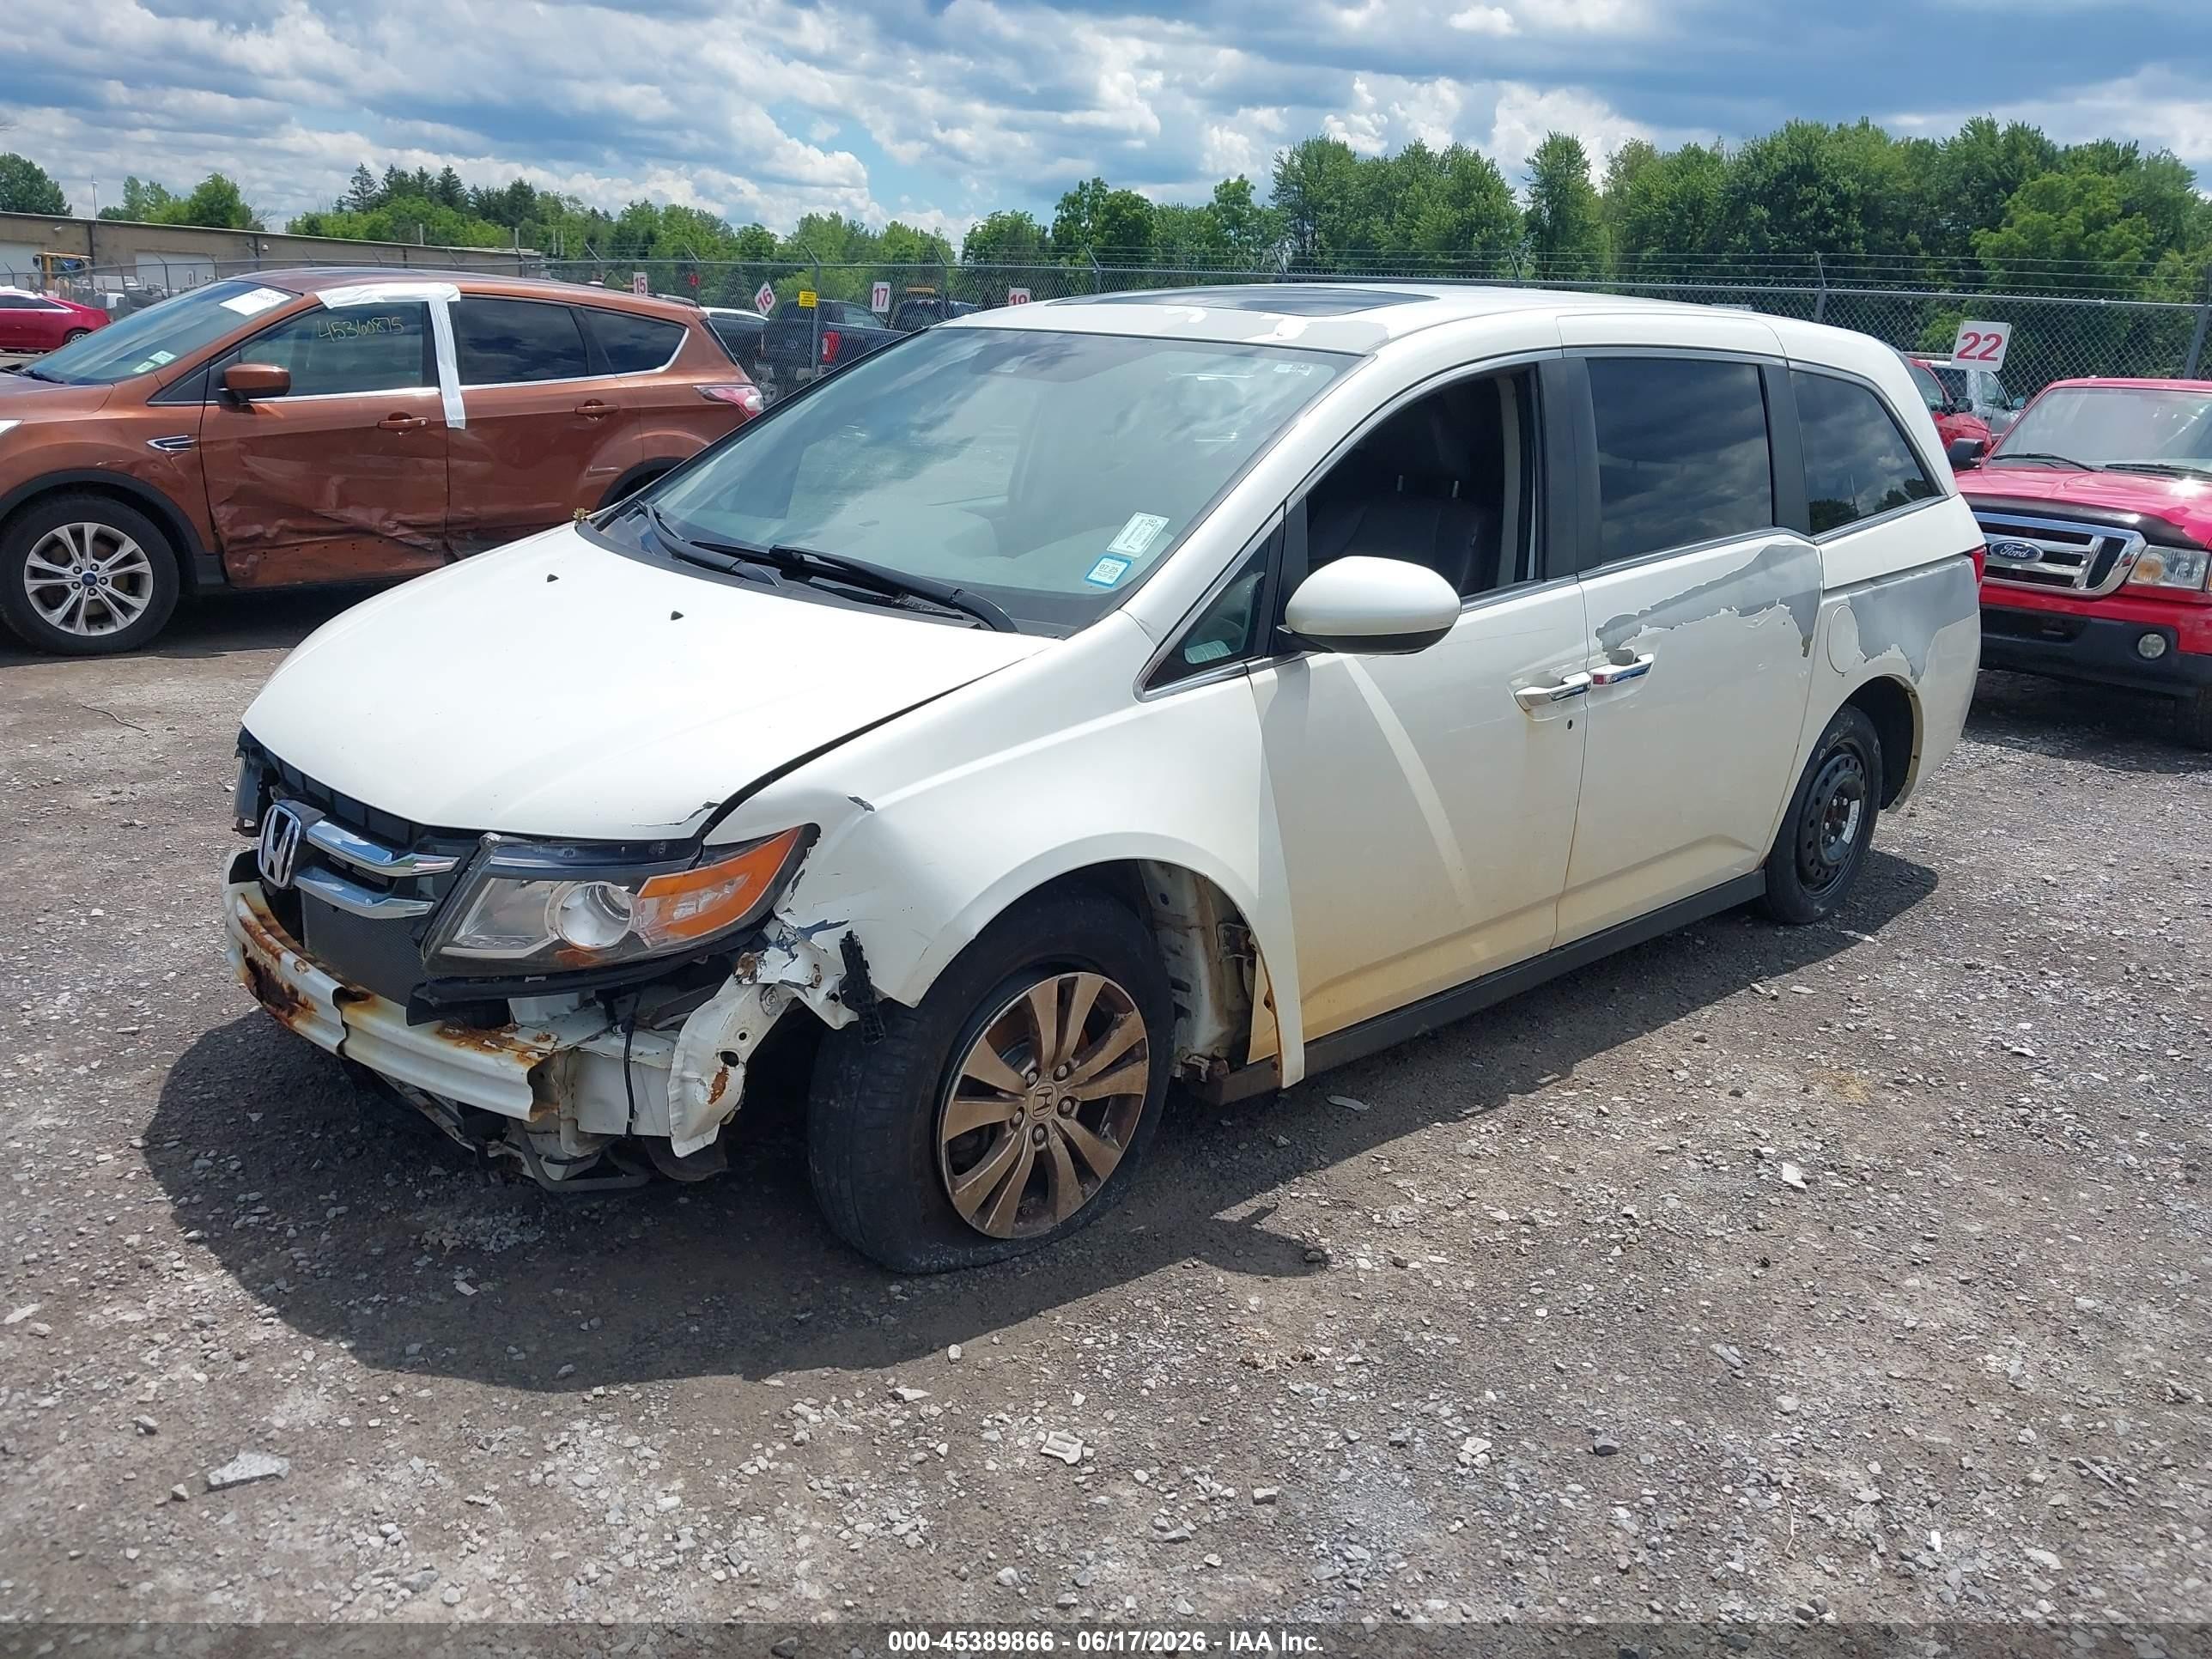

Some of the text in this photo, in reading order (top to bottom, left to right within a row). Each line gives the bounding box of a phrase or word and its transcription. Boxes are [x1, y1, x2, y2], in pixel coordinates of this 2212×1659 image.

[635, 276, 647, 295] 15
[757, 288, 772, 310] 16
[874, 288, 889, 307] 17
[1956, 331, 2002, 362] 22
[1999, 544, 2030, 558] Ford
